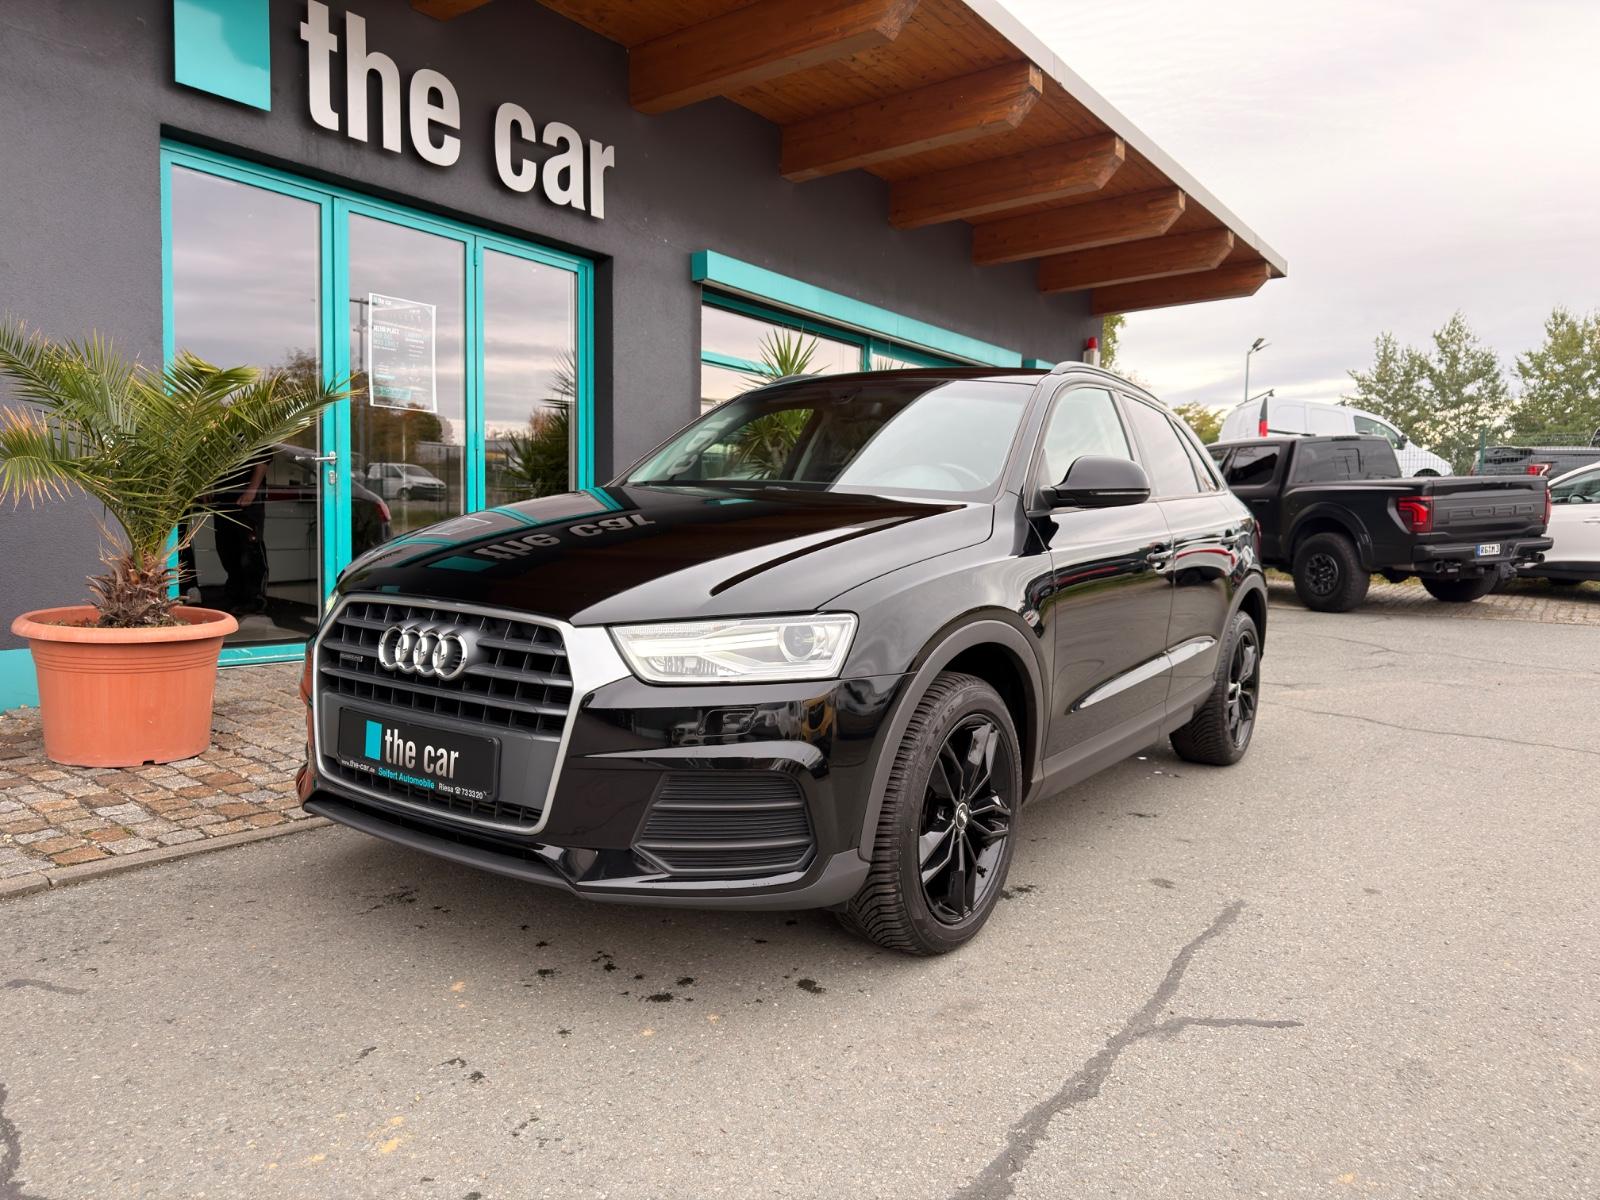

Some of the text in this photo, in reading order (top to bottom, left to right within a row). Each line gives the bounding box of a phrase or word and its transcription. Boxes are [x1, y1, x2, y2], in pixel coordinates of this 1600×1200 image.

[299, 0, 616, 220] the car
[1448, 504, 1535, 520] FORD
[385, 729, 459, 779] the car
[377, 768, 398, 781] Seifert
[399, 773, 435, 789] Automobile
[438, 782, 454, 793] Riesa
